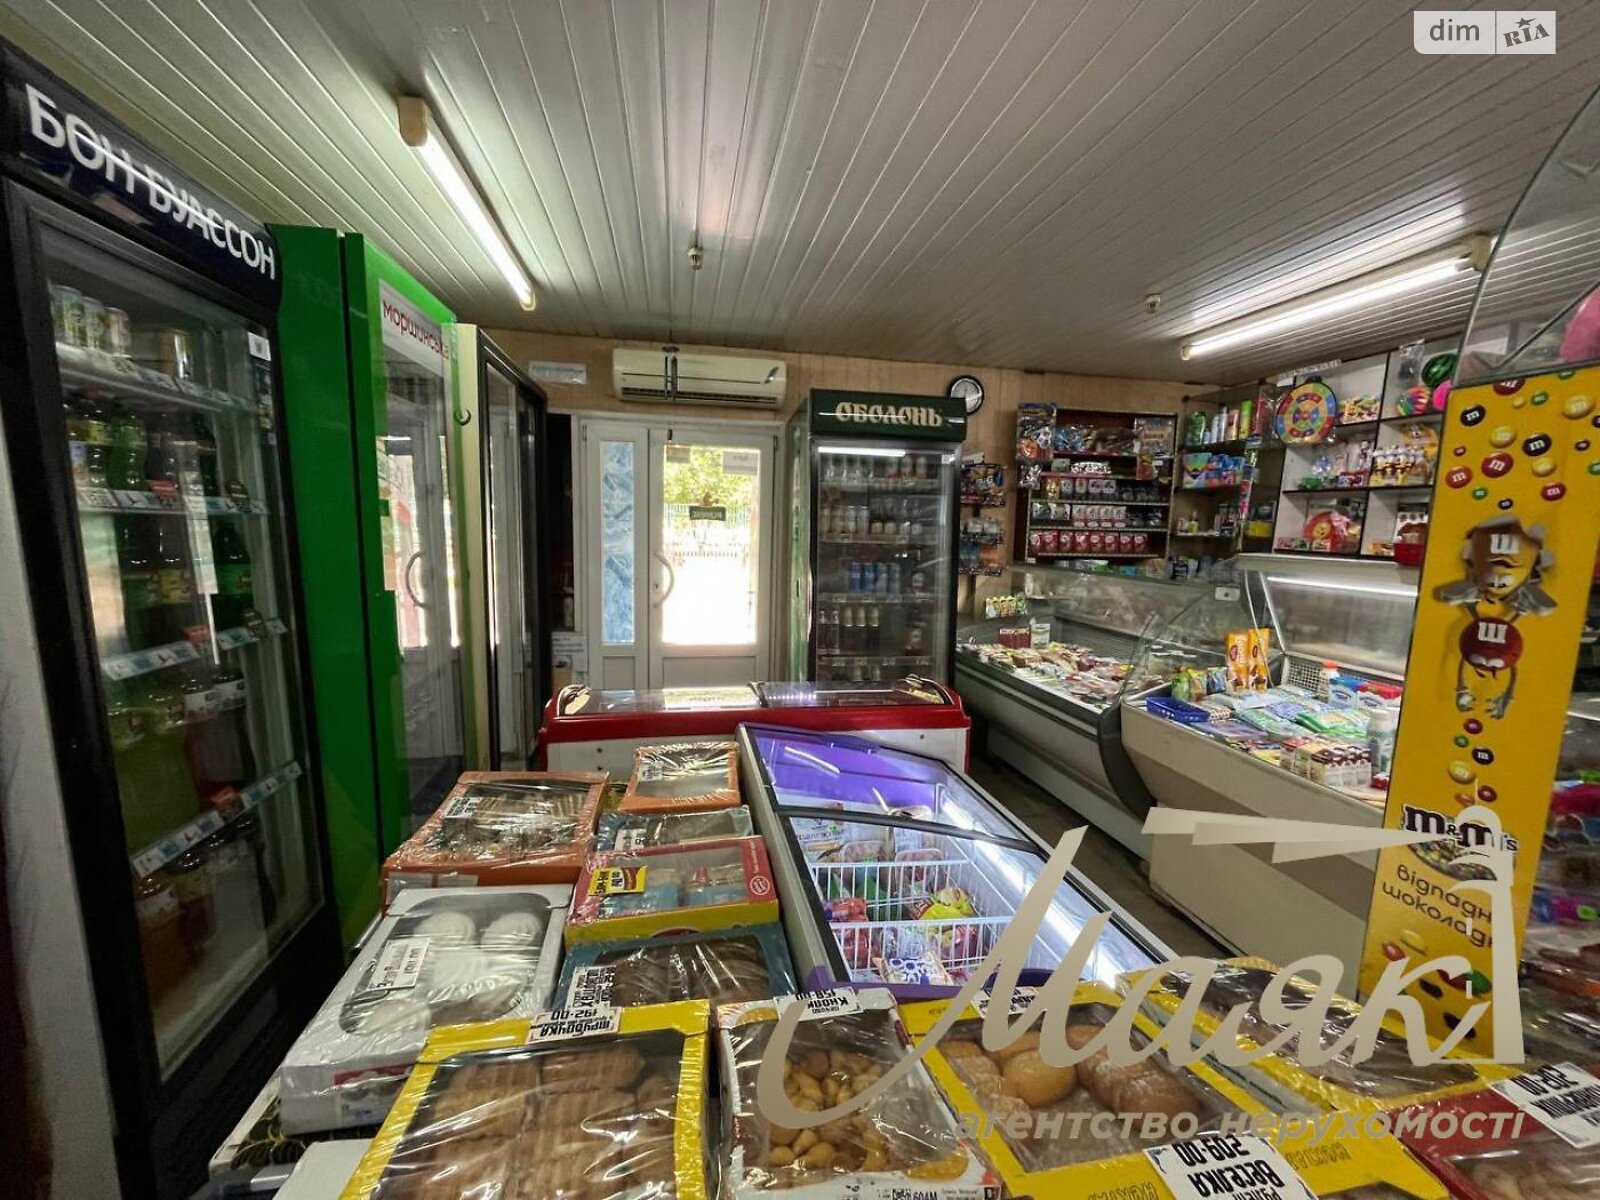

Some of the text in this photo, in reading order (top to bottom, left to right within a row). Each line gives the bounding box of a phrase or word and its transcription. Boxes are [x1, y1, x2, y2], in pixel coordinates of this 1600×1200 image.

[25, 83, 138, 194] БОН
[835, 401, 943, 428] ОБОЛОНЬ
[1382, 881, 1492, 947] шоколад
[1397, 864, 1492, 924] відпадн
